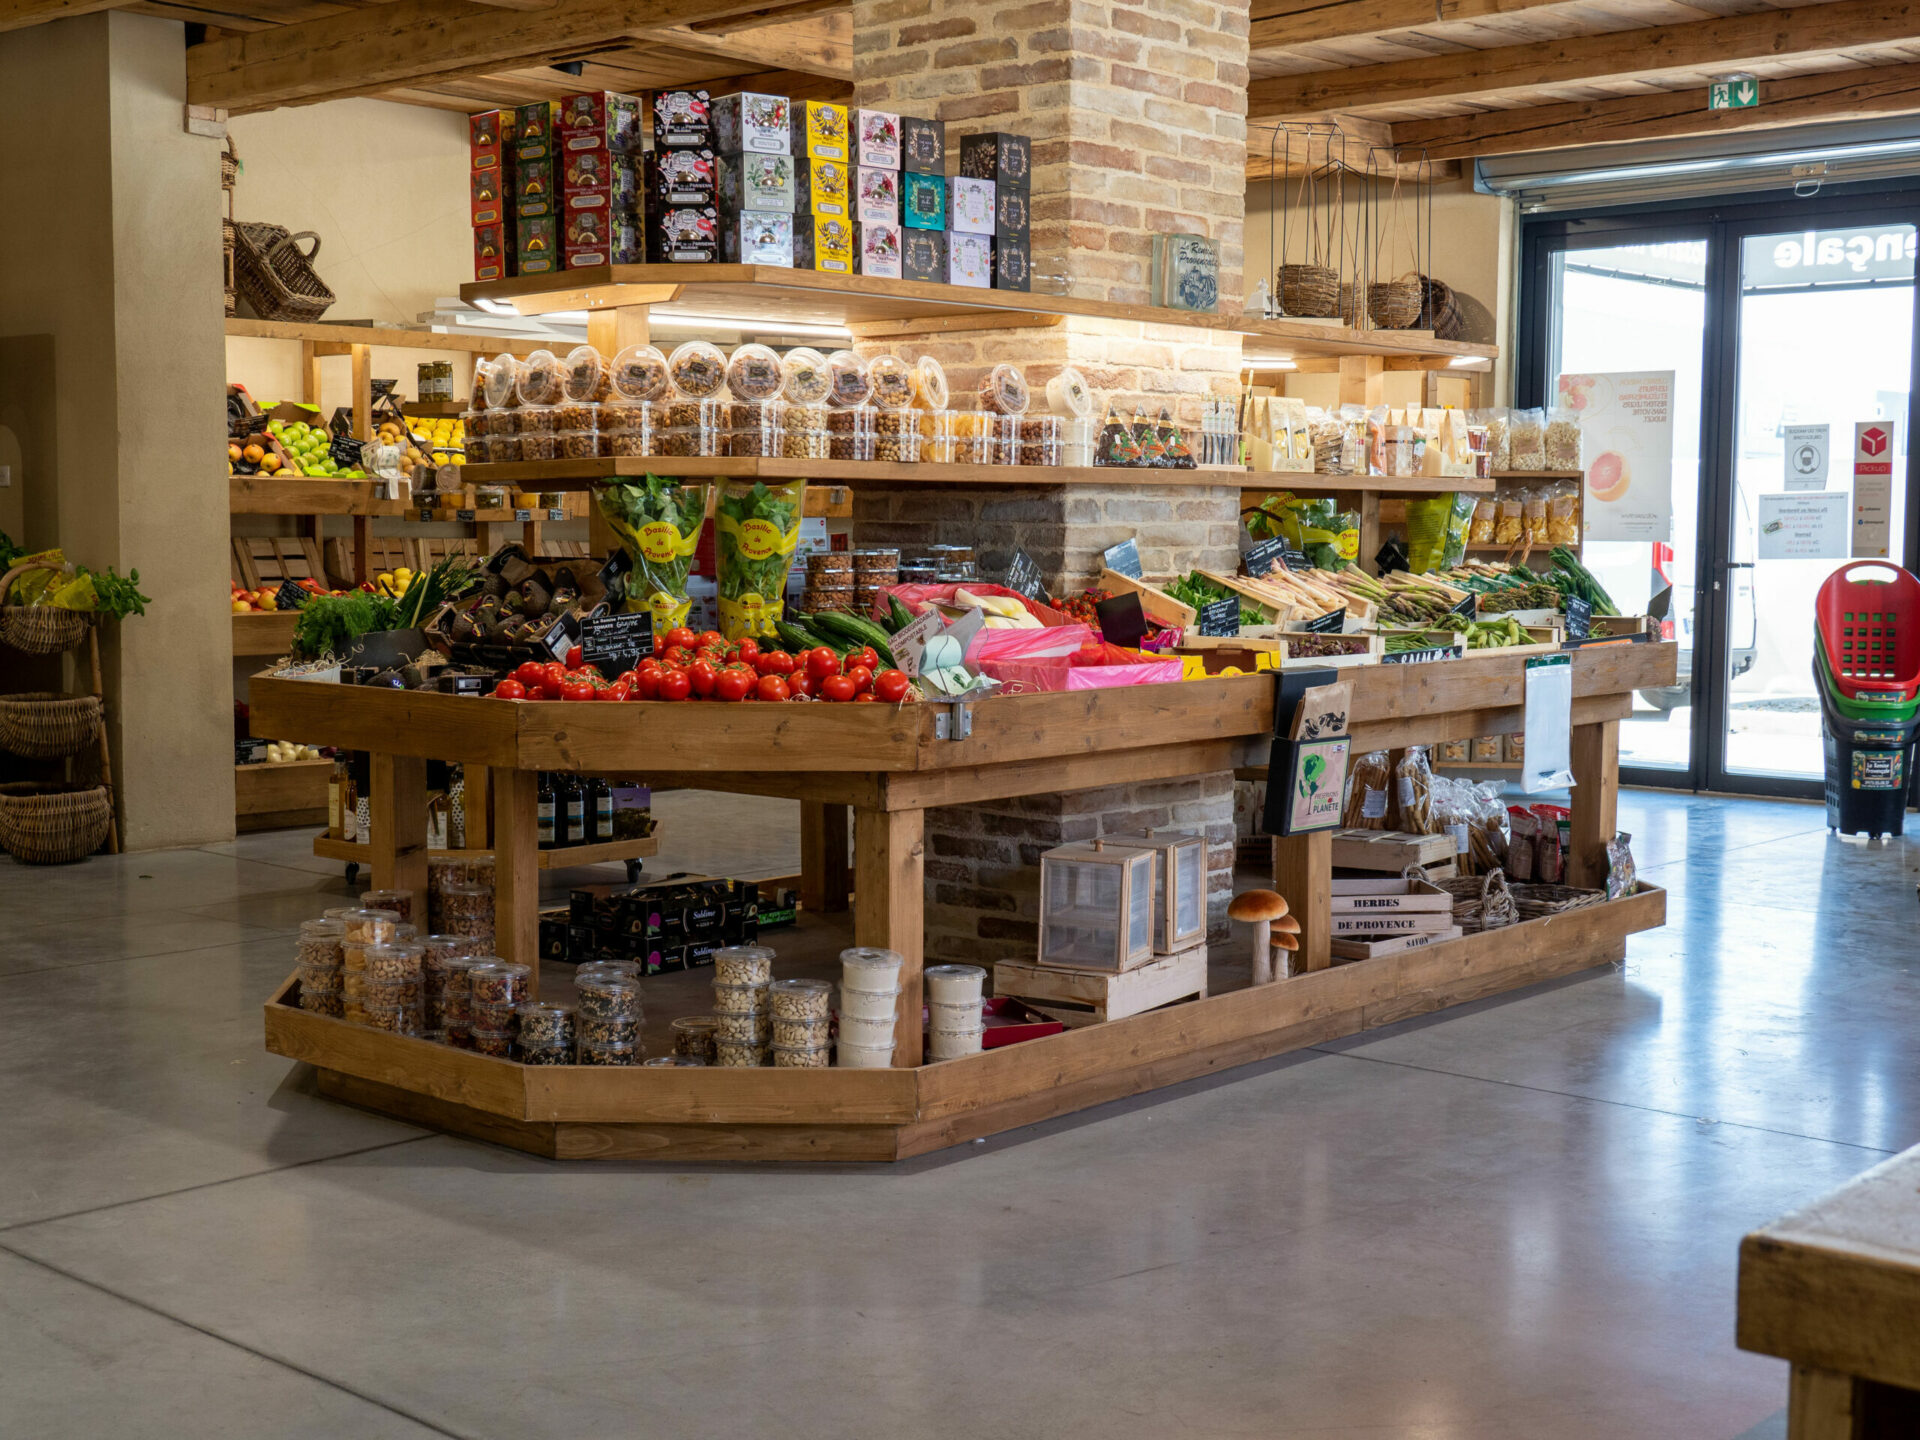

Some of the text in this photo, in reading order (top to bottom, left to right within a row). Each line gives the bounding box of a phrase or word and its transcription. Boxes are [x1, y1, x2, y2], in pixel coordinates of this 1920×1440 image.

[1859, 463, 1887, 473] Pickup
[644, 525, 673, 536] Basilic
[744, 523, 772, 535] Basilic
[742, 542, 772, 555] Provence
[895, 624, 928, 650] COMPOSTABLE
[1354, 899, 1399, 908] HERBES
[693, 910, 717, 920] Sublime
[1338, 919, 1416, 930] DE PROVENCE
[1406, 935, 1429, 948] SAVON
